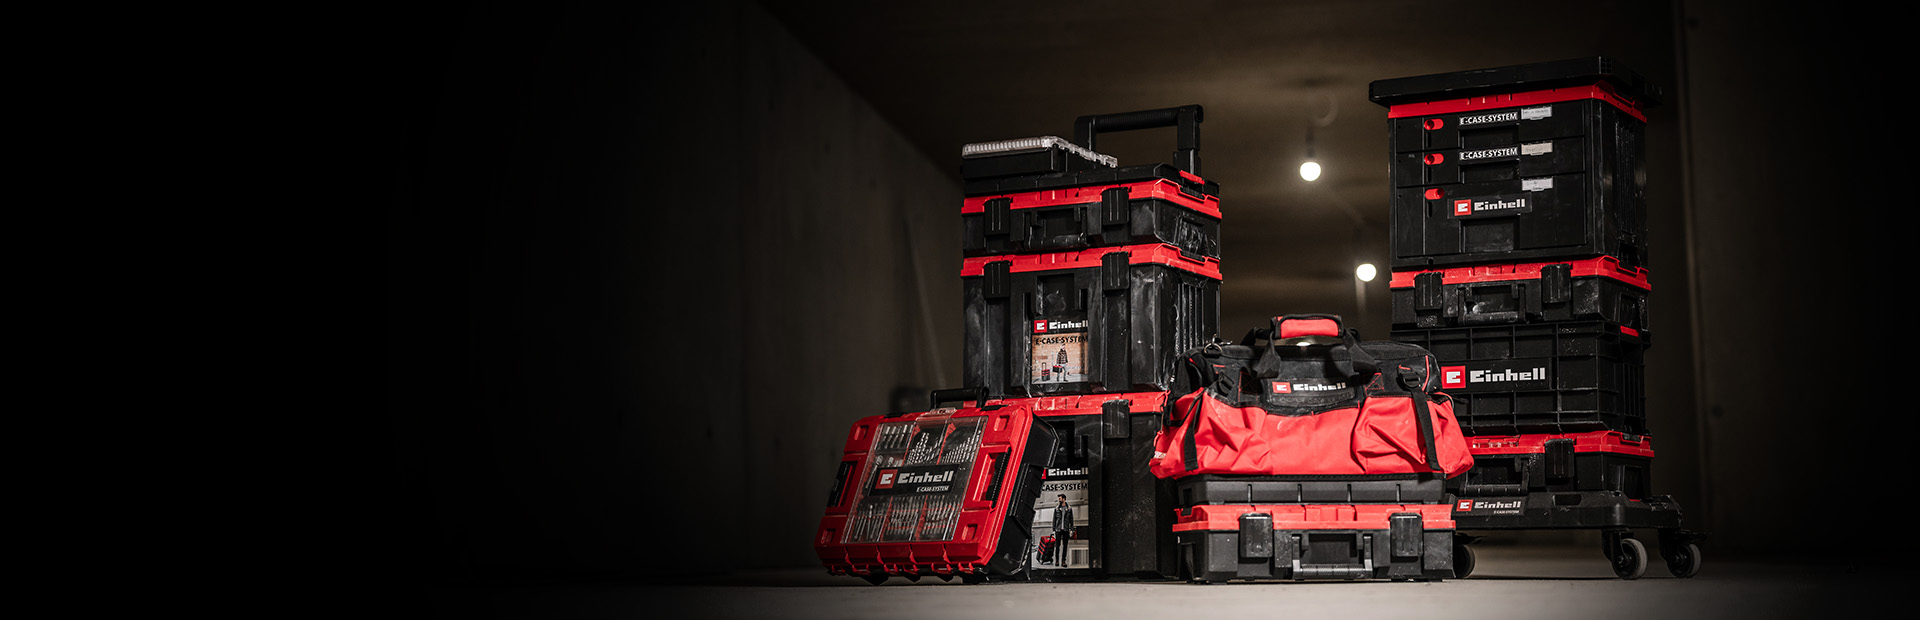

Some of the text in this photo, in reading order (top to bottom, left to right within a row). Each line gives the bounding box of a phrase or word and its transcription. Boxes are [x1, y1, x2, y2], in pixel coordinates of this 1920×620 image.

[1459, 112, 1518, 126] E-CASE-SYSTEM
[1459, 147, 1518, 161] E-CASE-SYSTEM
[1474, 198, 1526, 211] Einhell
[1049, 320, 1089, 330] Einhell
[1469, 367, 1546, 383] Einhell
[1293, 382, 1347, 391] Einhell
[897, 470, 954, 484] Einhell
[1048, 467, 1089, 476] Einhell
[1042, 483, 1089, 491] CASE-SYSTEM
[1474, 501, 1522, 509] Einhell
